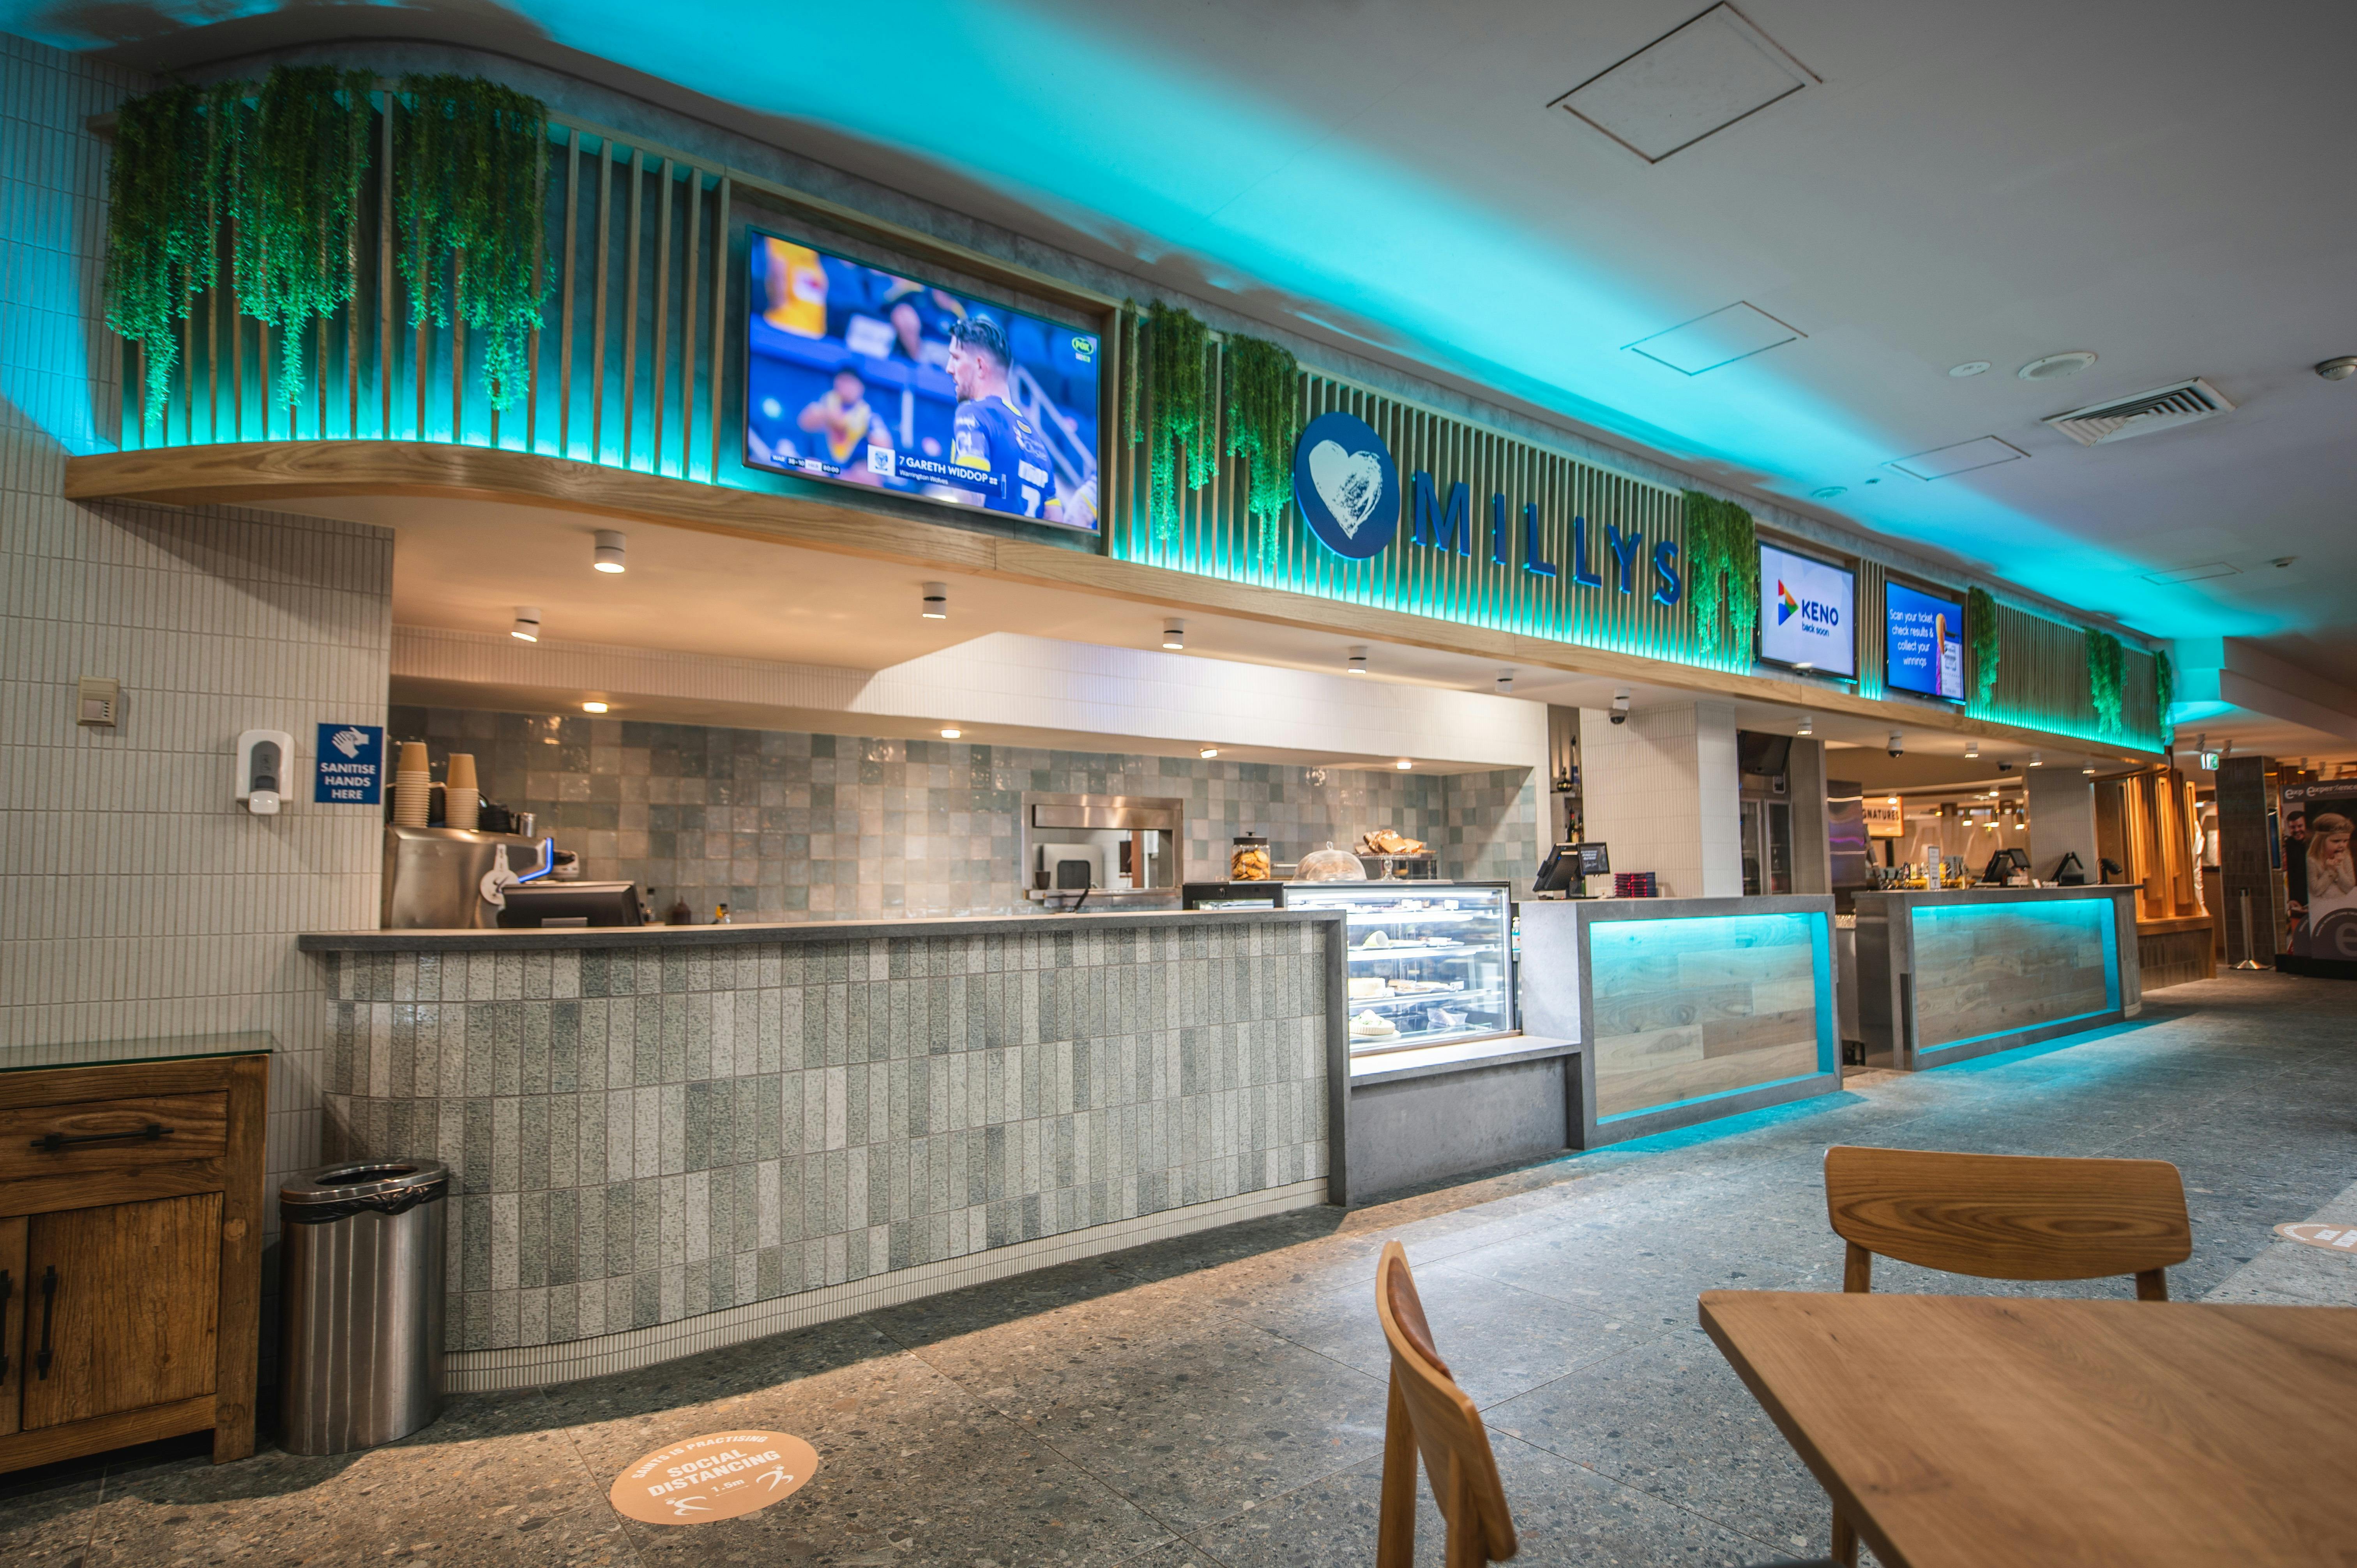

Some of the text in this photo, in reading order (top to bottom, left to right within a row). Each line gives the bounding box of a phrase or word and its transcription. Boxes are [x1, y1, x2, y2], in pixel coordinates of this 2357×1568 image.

[1075, 340, 1090, 352] FOX
[899, 456, 988, 483] 7 GARETH WIDDOP
[899, 469, 949, 485] Warrington Wolves
[1412, 470, 1681, 606] MILLYS
[1802, 599, 1839, 626] KENO
[1890, 608, 1934, 624] Scan your ticket,
[1802, 621, 1829, 637] back soon
[1892, 624, 1934, 638] check results &
[1898, 639, 1930, 654] collect your
[1903, 655, 1927, 669] winnings
[320, 762, 376, 775] SANITISE
[324, 775, 371, 787] HANDS
[331, 789, 363, 800] HERE
[631, 1455, 670, 1478] SAINTS
[686, 1436, 768, 1450] PRACTISING
[667, 1449, 747, 1478] SOCIAL
[647, 1450, 781, 1497] DISTANCING
[710, 1478, 745, 1492] 1.5m
